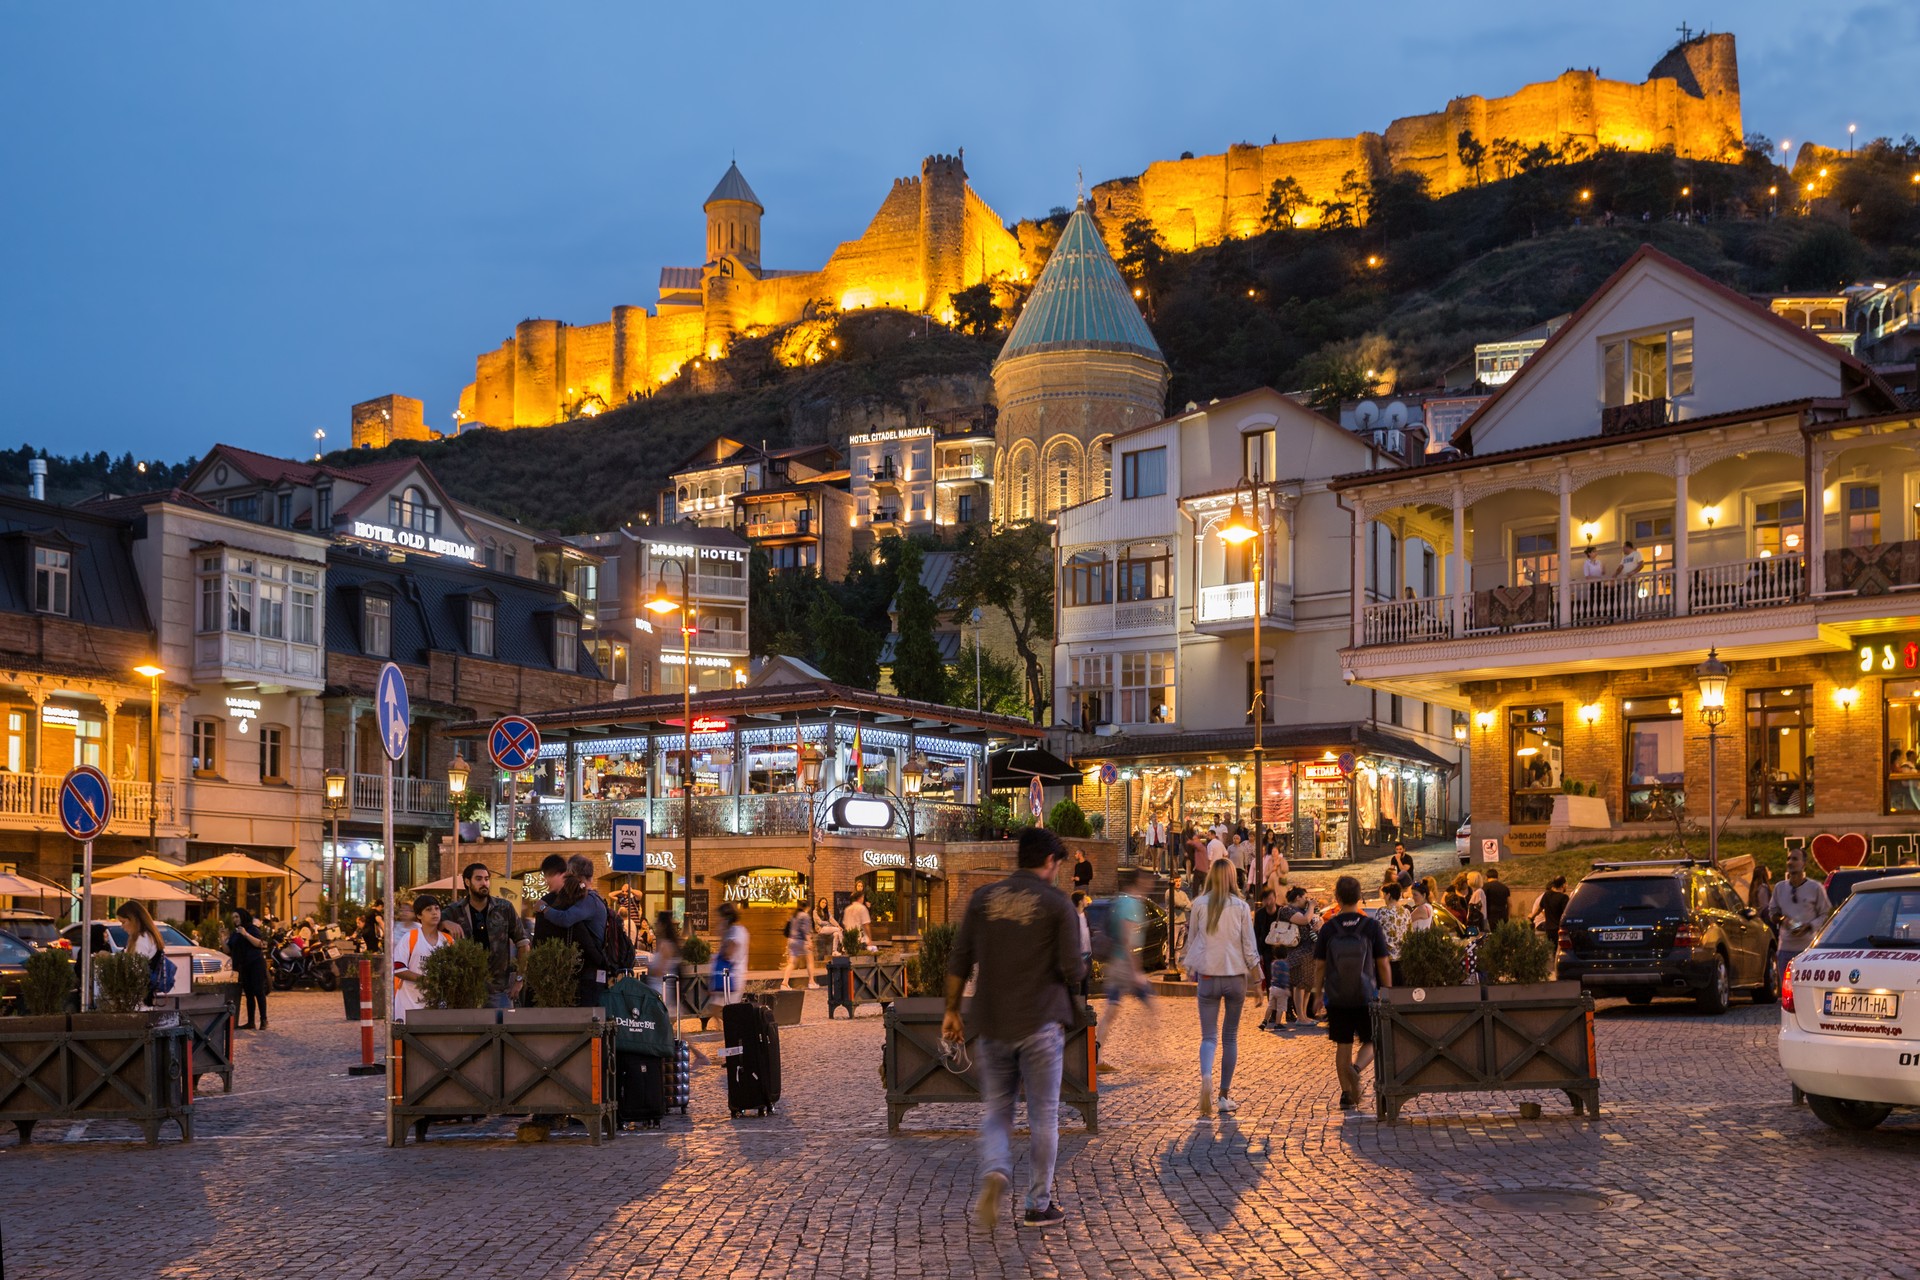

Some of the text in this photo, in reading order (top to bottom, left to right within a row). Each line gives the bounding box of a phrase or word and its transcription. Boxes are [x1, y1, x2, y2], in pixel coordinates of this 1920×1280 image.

[850, 427, 931, 445] HOTEL CITADEL NARIKALA
[354, 521, 475, 560] HOTEL OLD MEIDAN
[701, 549, 744, 562] HOTEL
[238, 718, 248, 734] 6
[724, 882, 807, 901] MUKHNI
[1802, 951, 1920, 962] VICTORIA SECURI
[1795, 970, 1841, 982] 2 50 50 90
[1833, 996, 1888, 1013] AH-911-HA
[615, 1016, 628, 1026] Del
[1820, 1022, 1903, 1036] www.victoriasecurity.ge
